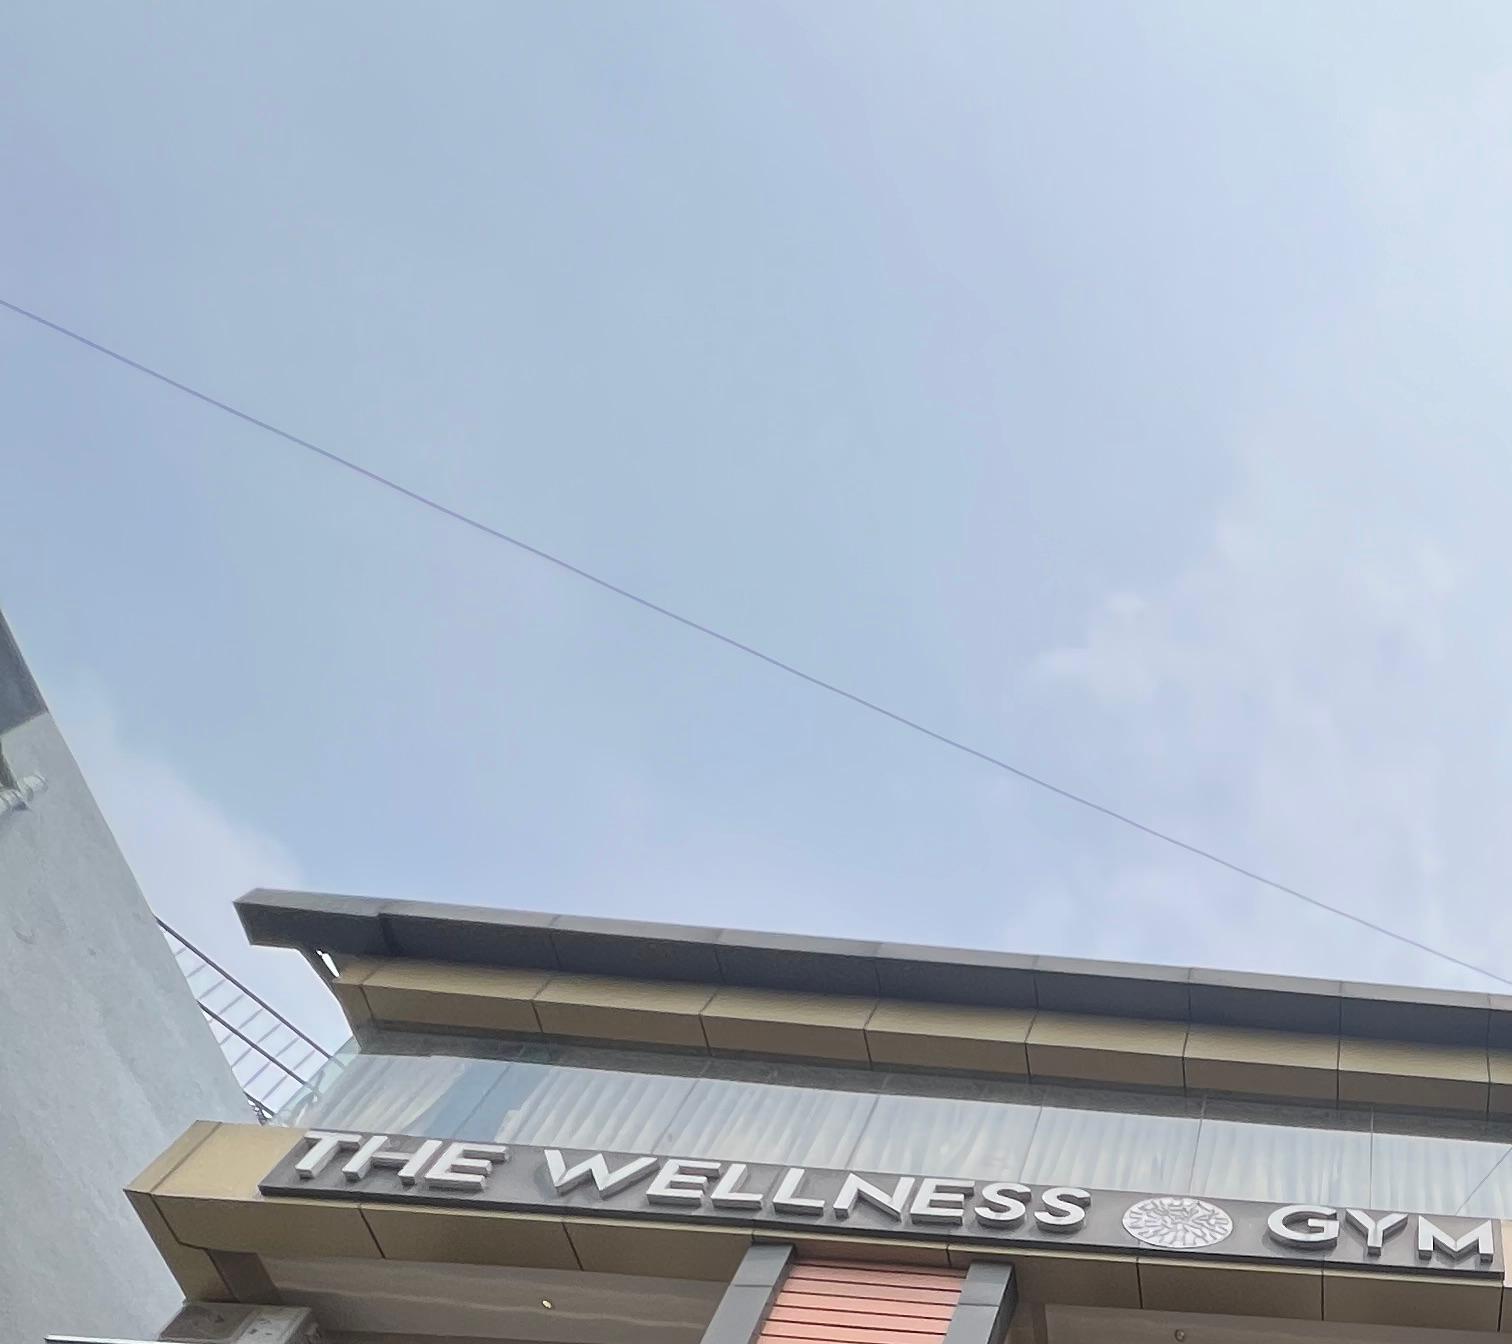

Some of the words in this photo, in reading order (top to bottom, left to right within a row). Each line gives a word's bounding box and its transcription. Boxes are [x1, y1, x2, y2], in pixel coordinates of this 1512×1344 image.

[295, 1130, 509, 1193] THE
[544, 1149, 1091, 1232] WELLNESS
[1267, 1204, 1495, 1264] GYM
